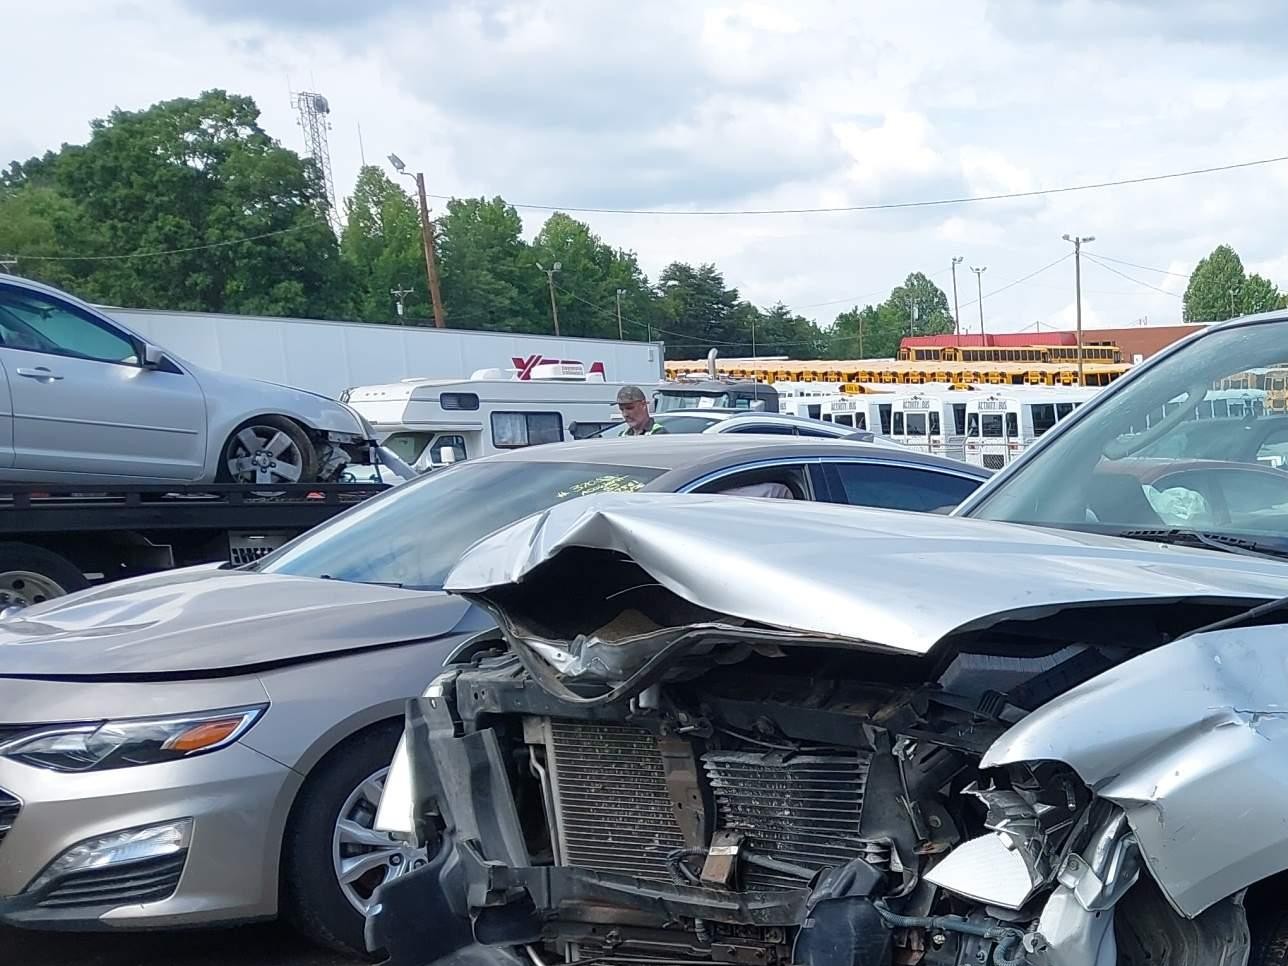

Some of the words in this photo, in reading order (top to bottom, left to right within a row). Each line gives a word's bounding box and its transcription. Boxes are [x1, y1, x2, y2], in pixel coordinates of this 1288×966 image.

[902, 401, 919, 409] ACTIVITY
[922, 401, 930, 409] BUS
[978, 401, 997, 410] ACTIVITY
[998, 401, 1007, 410] BUS
